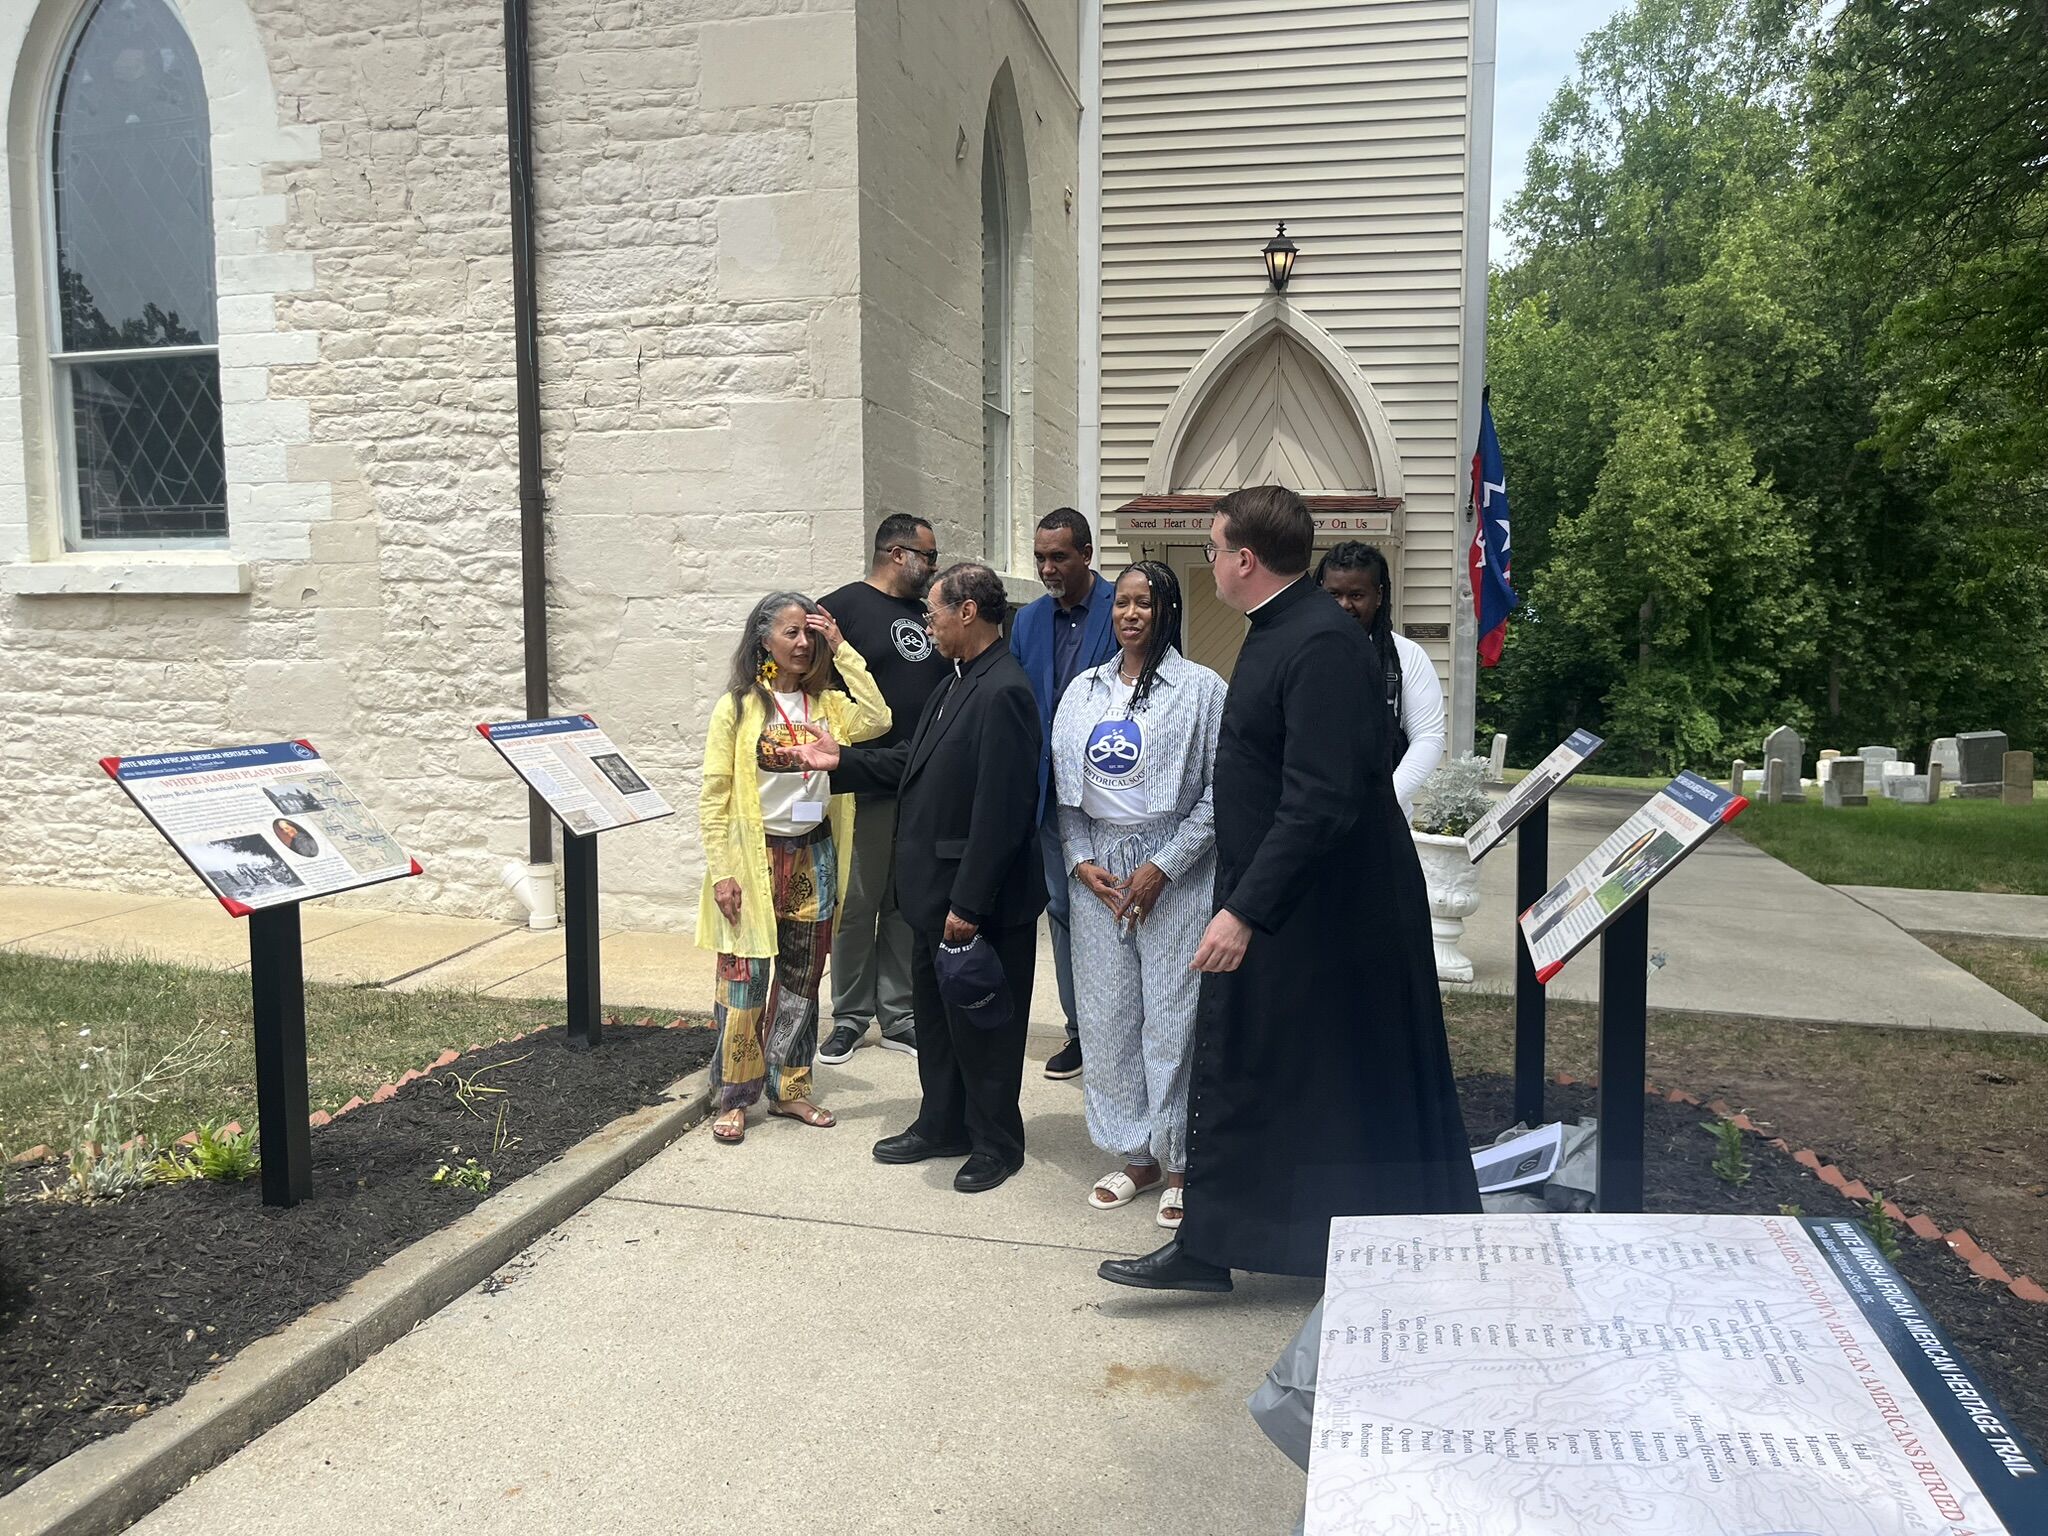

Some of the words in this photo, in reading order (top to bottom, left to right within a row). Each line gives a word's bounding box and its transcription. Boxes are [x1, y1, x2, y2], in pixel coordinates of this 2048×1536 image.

[1130, 518, 1156, 528] Sacred
[1164, 518, 1186, 528] Heart
[1192, 518, 1203, 528] Of
[1332, 518, 1347, 528] On
[1356, 518, 1368, 528] Us
[137, 758, 162, 767] MARSH
[162, 756, 190, 764] AFRICAN
[190, 752, 222, 761] AMERICAN
[222, 750, 252, 758] HERITAGE
[160, 776, 201, 788] WHITE
[201, 771, 240, 784] MARSH
[240, 764, 305, 780] PLANTATION
[1760, 1218, 1800, 1264] SURNAMES
[1812, 1226, 1830, 1238] White
[1350, 1249, 1361, 1262] Chase
[1394, 1244, 1408, 1266] Campbell
[1820, 1238, 1838, 1252] Marsh
[1791, 1266, 1814, 1278] OF
[1830, 1252, 1852, 1275] Historical
[1800, 1279, 1837, 1320] KNOWN
[1378, 1309, 1392, 1330] Grayson
[1395, 1318, 1410, 1332] Gray
[1415, 1316, 1427, 1330] Giles
[1612, 1316, 1626, 1332] Diggs
[1326, 1330, 1340, 1341] Guy
[1346, 1326, 1358, 1344] Griffin
[1364, 1326, 1374, 1344] Green
[1395, 1333, 1410, 1352] (Grey)
[1414, 1332, 1428, 1354] (Childs)
[1434, 1325, 1446, 1345] Garner
[1451, 1324, 1464, 1347] Gardner
[1470, 1326, 1482, 1343] Gantt
[1487, 1324, 1500, 1346] Gaither
[1504, 1323, 1520, 1348] Franklin
[1524, 1328, 1538, 1342] Ford
[1542, 1324, 1556, 1348] Fletcher
[1561, 1328, 1574, 1344] Fleet
[1579, 1326, 1594, 1346] Duvall
[1597, 1324, 1614, 1349] Douglas
[1636, 1328, 1650, 1346] Deale
[1653, 1324, 1674, 1352] Crawford
[1672, 1328, 1690, 1348] Contee
[1692, 1326, 1710, 1352] Coleman
[1378, 1332, 1392, 1363] (Graceson)
[1616, 1334, 1638, 1360] (Digges)
[1732, 1336, 1756, 1360] (Clarke)
[1826, 1322, 1876, 1373] AFRICAN
[1830, 1222, 1865, 1246] WHITE
[1848, 1246, 1888, 1276] MARSH
[1870, 1276, 1919, 1316] AFRICAN
[1900, 1318, 1960, 1372] AMERICAN
[1940, 1374, 2008, 1434] HERITAGE
[1986, 1436, 2038, 1478] TRAIL
[1688, 1414, 1710, 1443] Hebron
[1858, 1376, 1927, 1458] AMERICANS
[1318, 1429, 1333, 1449] Savoy
[1340, 1431, 1354, 1448] Ross
[1360, 1423, 1374, 1458] Robinson
[1381, 1426, 1394, 1454] Randall
[1398, 1428, 1414, 1453] Queen
[1421, 1430, 1434, 1451] Prout
[1442, 1429, 1456, 1454] Powell
[1462, 1429, 1476, 1454] Patton
[1482, 1430, 1496, 1454] Parker
[1503, 1427, 1520, 1458] Mitchell
[1524, 1432, 1538, 1454] Miller
[1546, 1436, 1560, 1451] Lee
[1562, 1433, 1580, 1455] Jones
[1583, 1428, 1604, 1460] Johnson
[1604, 1430, 1626, 1460] Jackson
[1629, 1430, 1650, 1462] Holland
[1652, 1432, 1670, 1462] Henson
[1673, 1434, 1692, 1459] Henry
[1716, 1433, 1738, 1464] Herbert
[1737, 1432, 1760, 1466] Hawkins
[1759, 1432, 1784, 1467] Harrison
[1783, 1438, 1805, 1463] Harris
[1804, 1436, 1828, 1466] Hanson
[1824, 1432, 1852, 1470] Hamilton
[1851, 1442, 1872, 1460] Hall
[1696, 1444, 1726, 1484] (Heverin)
[1910, 1460, 1966, 1522] BURIED
